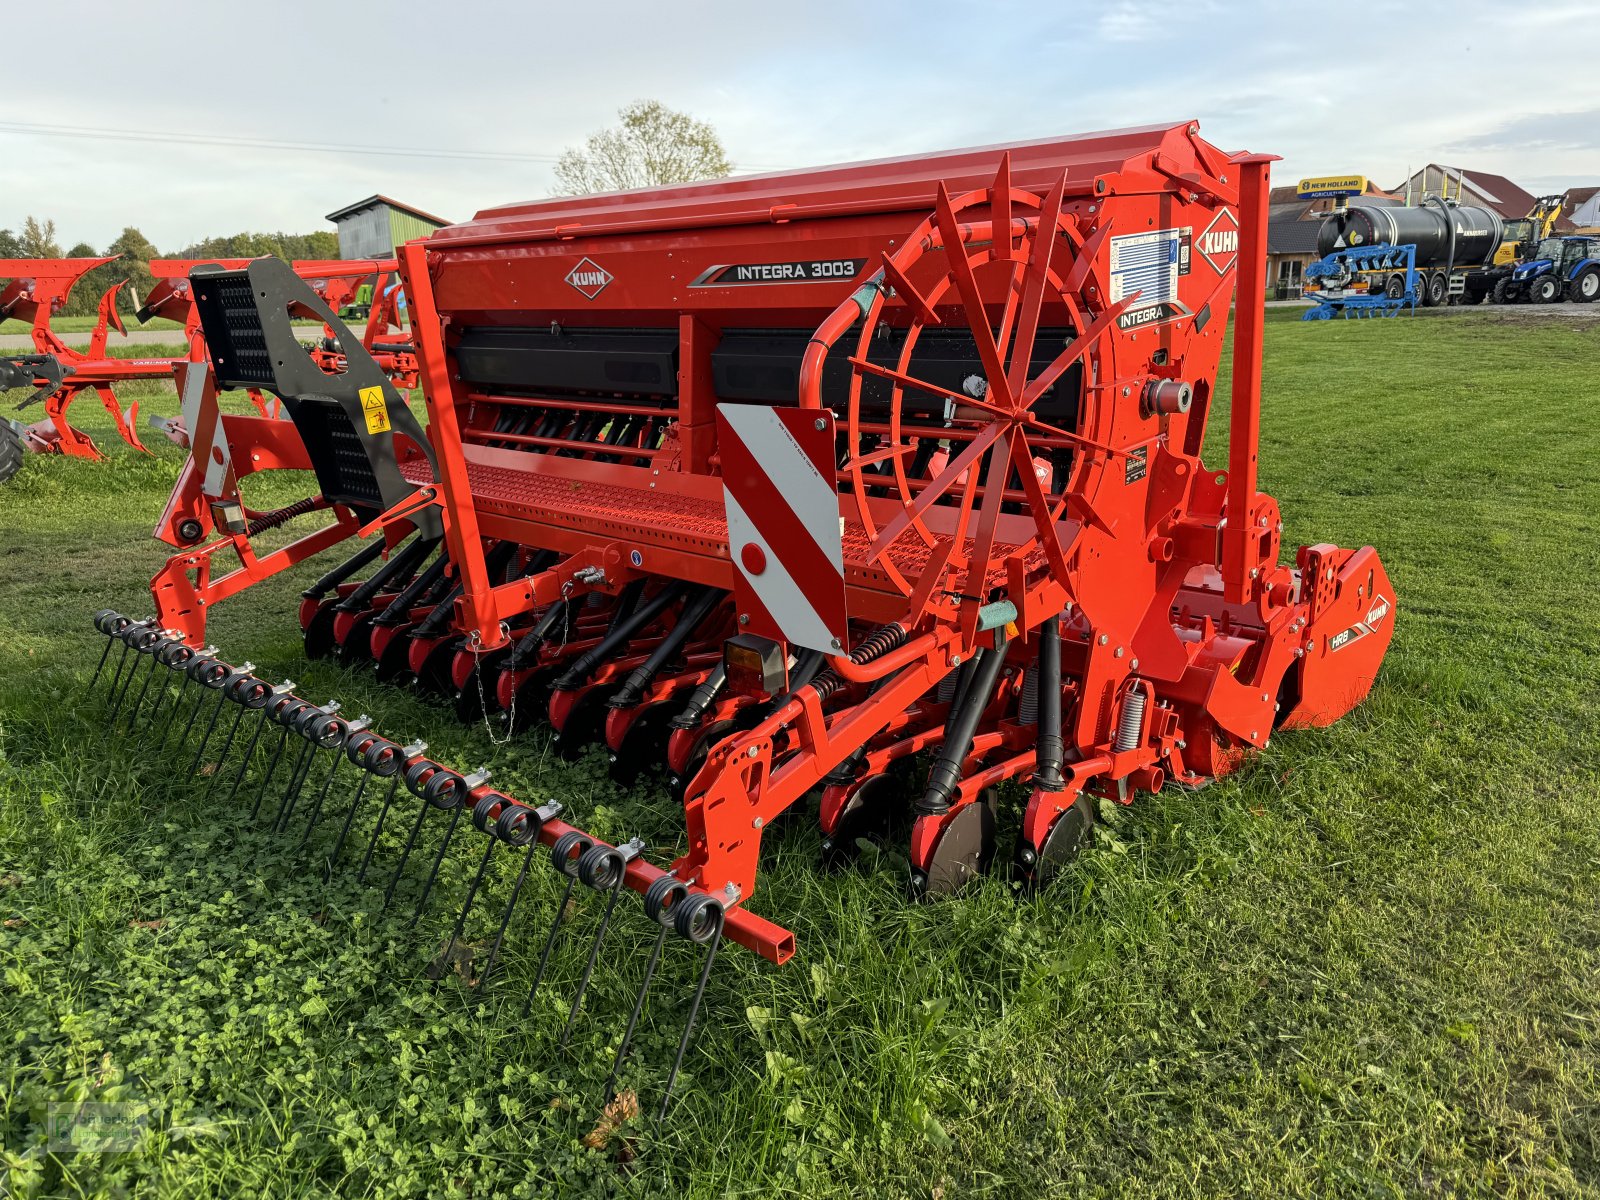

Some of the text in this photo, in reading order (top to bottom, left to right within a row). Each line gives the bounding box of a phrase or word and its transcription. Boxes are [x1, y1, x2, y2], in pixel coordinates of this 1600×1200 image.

[1327, 180, 1359, 188] HOLLAND
[572, 271, 606, 286] KUHN
[737, 261, 855, 280] INTEGRA 3003
[1120, 305, 1164, 328] INTEGRA
[1367, 602, 1387, 625] KUHN
[1332, 629, 1349, 649] HRB
